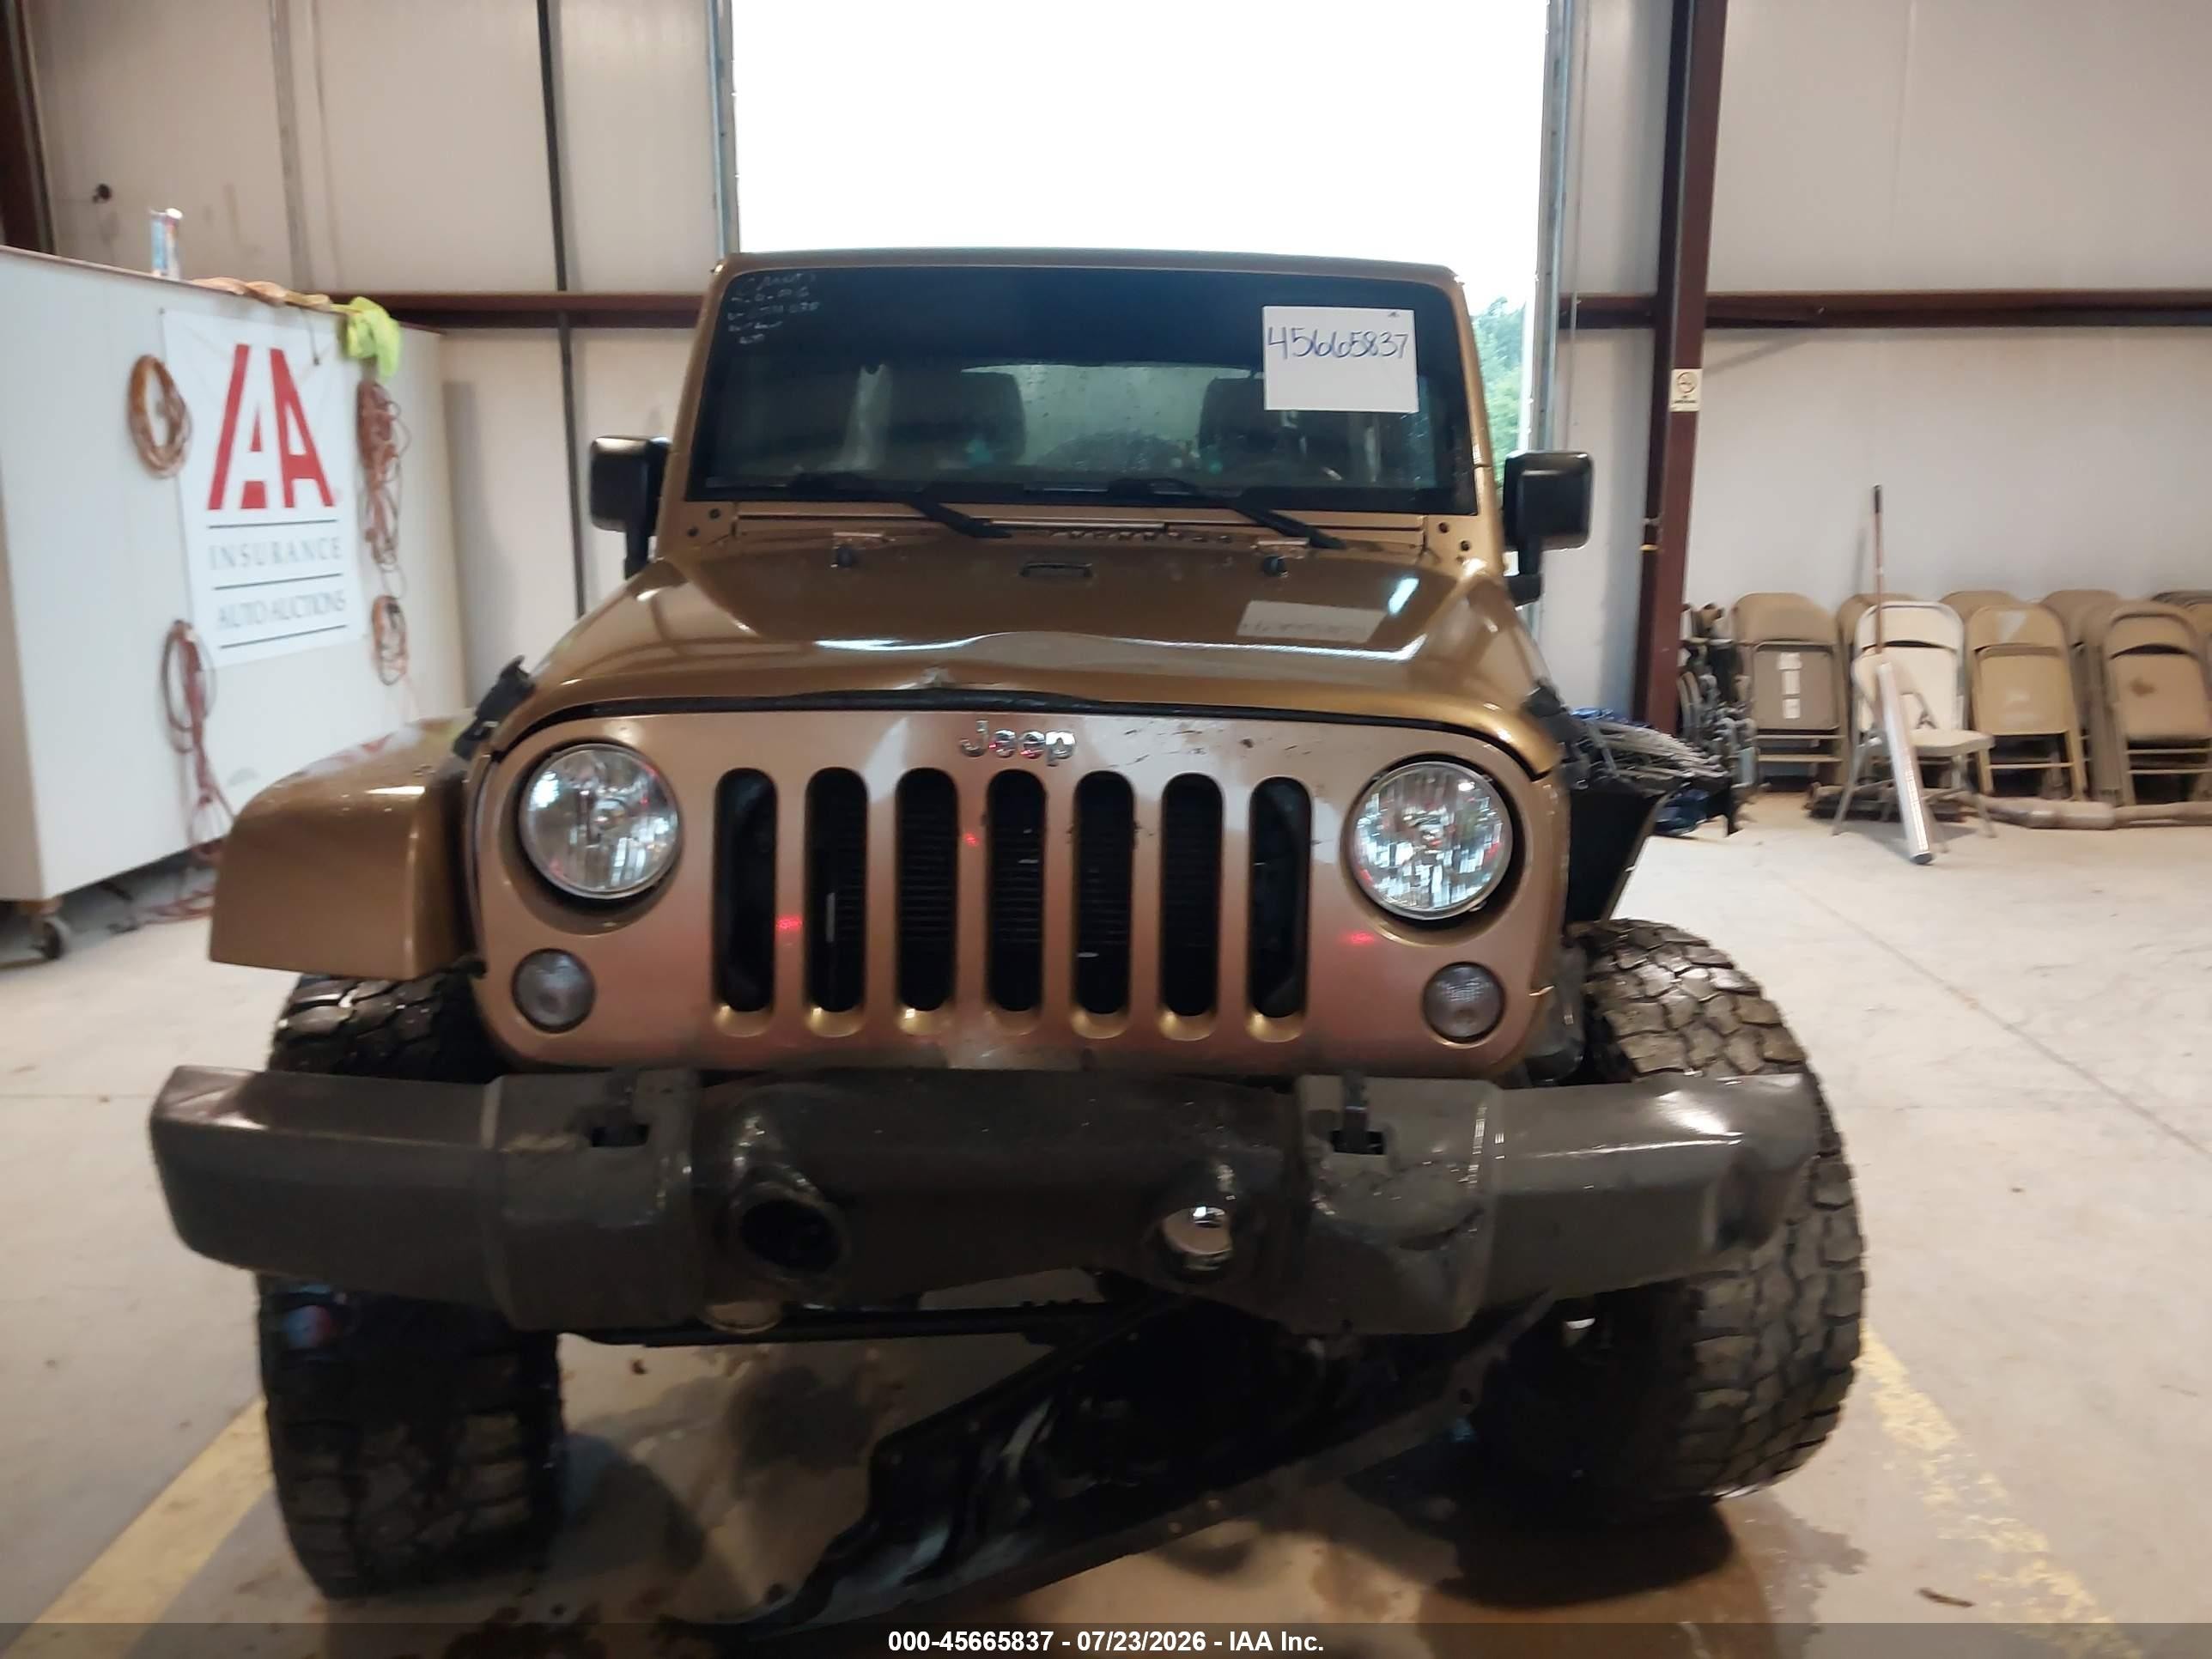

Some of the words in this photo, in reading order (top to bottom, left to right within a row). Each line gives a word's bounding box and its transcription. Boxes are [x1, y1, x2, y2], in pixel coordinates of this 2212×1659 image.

[1267, 325, 1409, 360] 45665837
[208, 537, 343, 570] INSURANCE
[216, 599, 268, 630] AUTO
[270, 590, 346, 622] AUCTIONS
[958, 720, 1076, 767] Jeep
